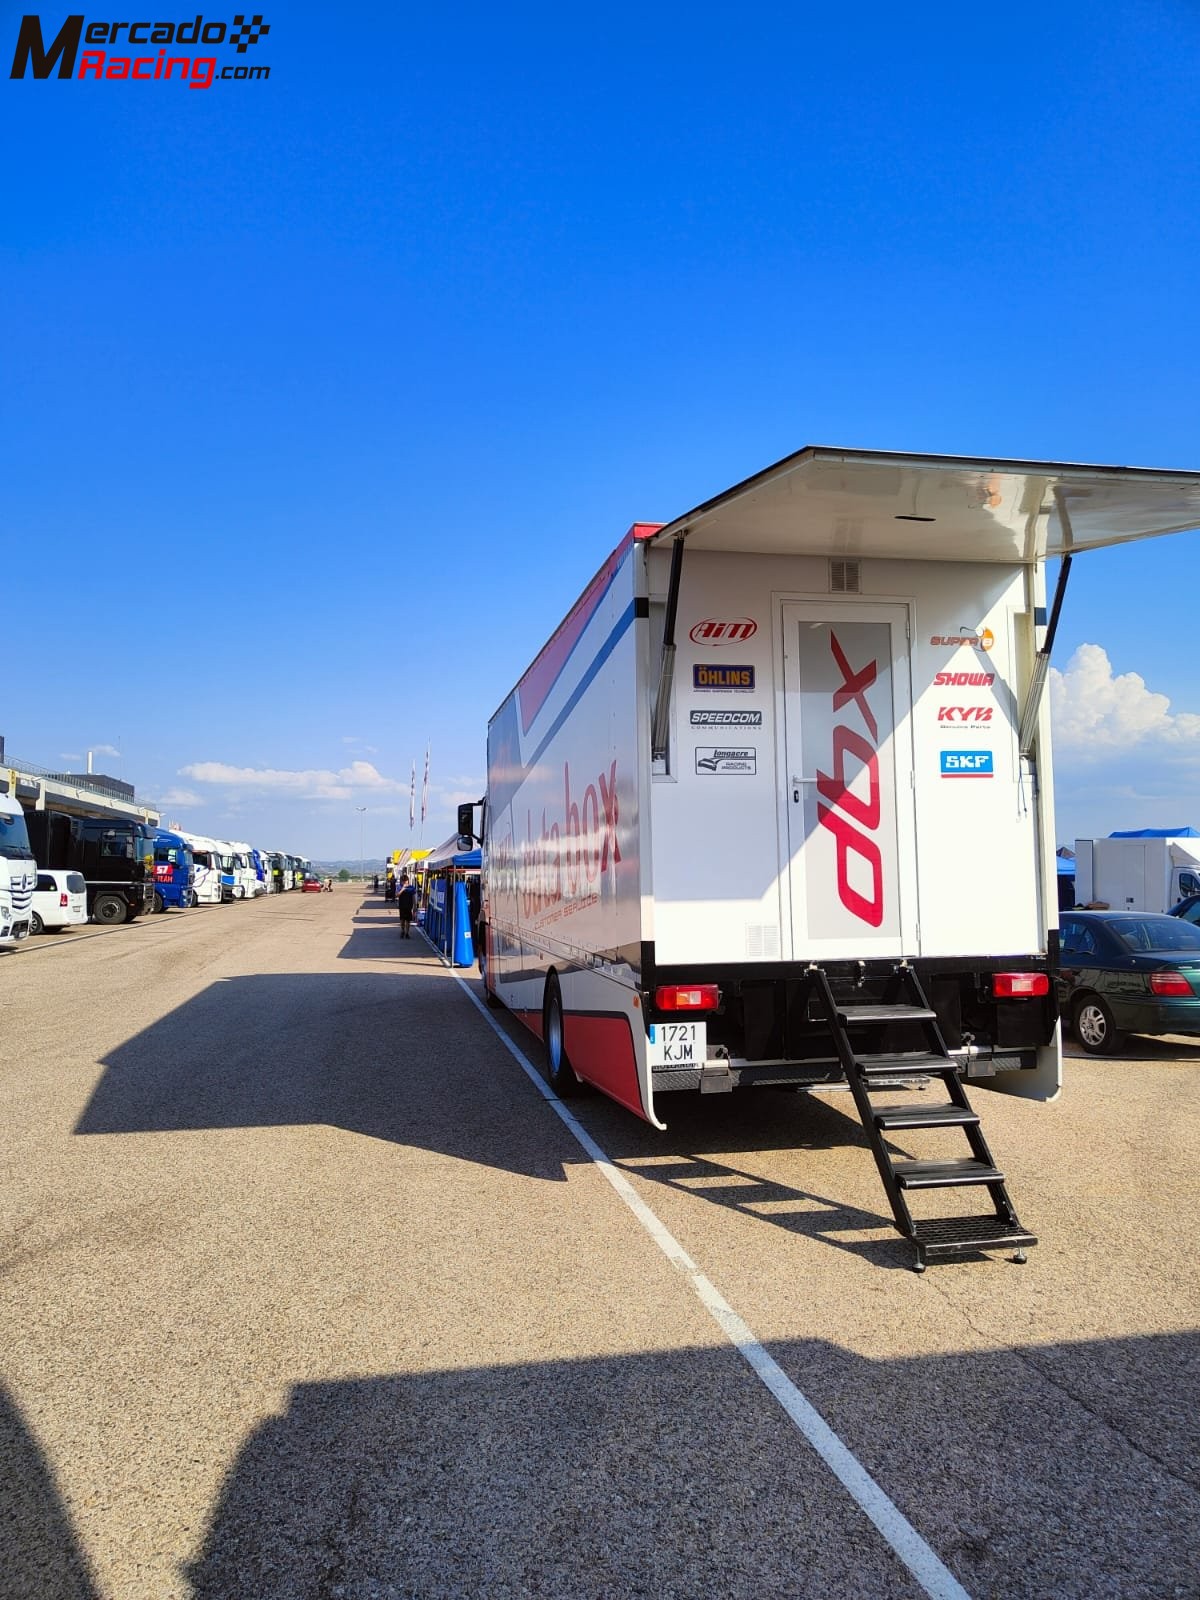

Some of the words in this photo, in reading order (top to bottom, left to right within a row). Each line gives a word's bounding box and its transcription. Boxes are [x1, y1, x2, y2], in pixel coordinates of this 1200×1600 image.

[698, 667, 750, 685] ÖHLINS
[933, 672, 995, 686] SHOWA
[691, 712, 761, 724] SPEEDCOM
[937, 707, 993, 721] KYB
[945, 755, 989, 768] SKF
[661, 1025, 696, 1042] 1721
[664, 1044, 693, 1060] KJM
